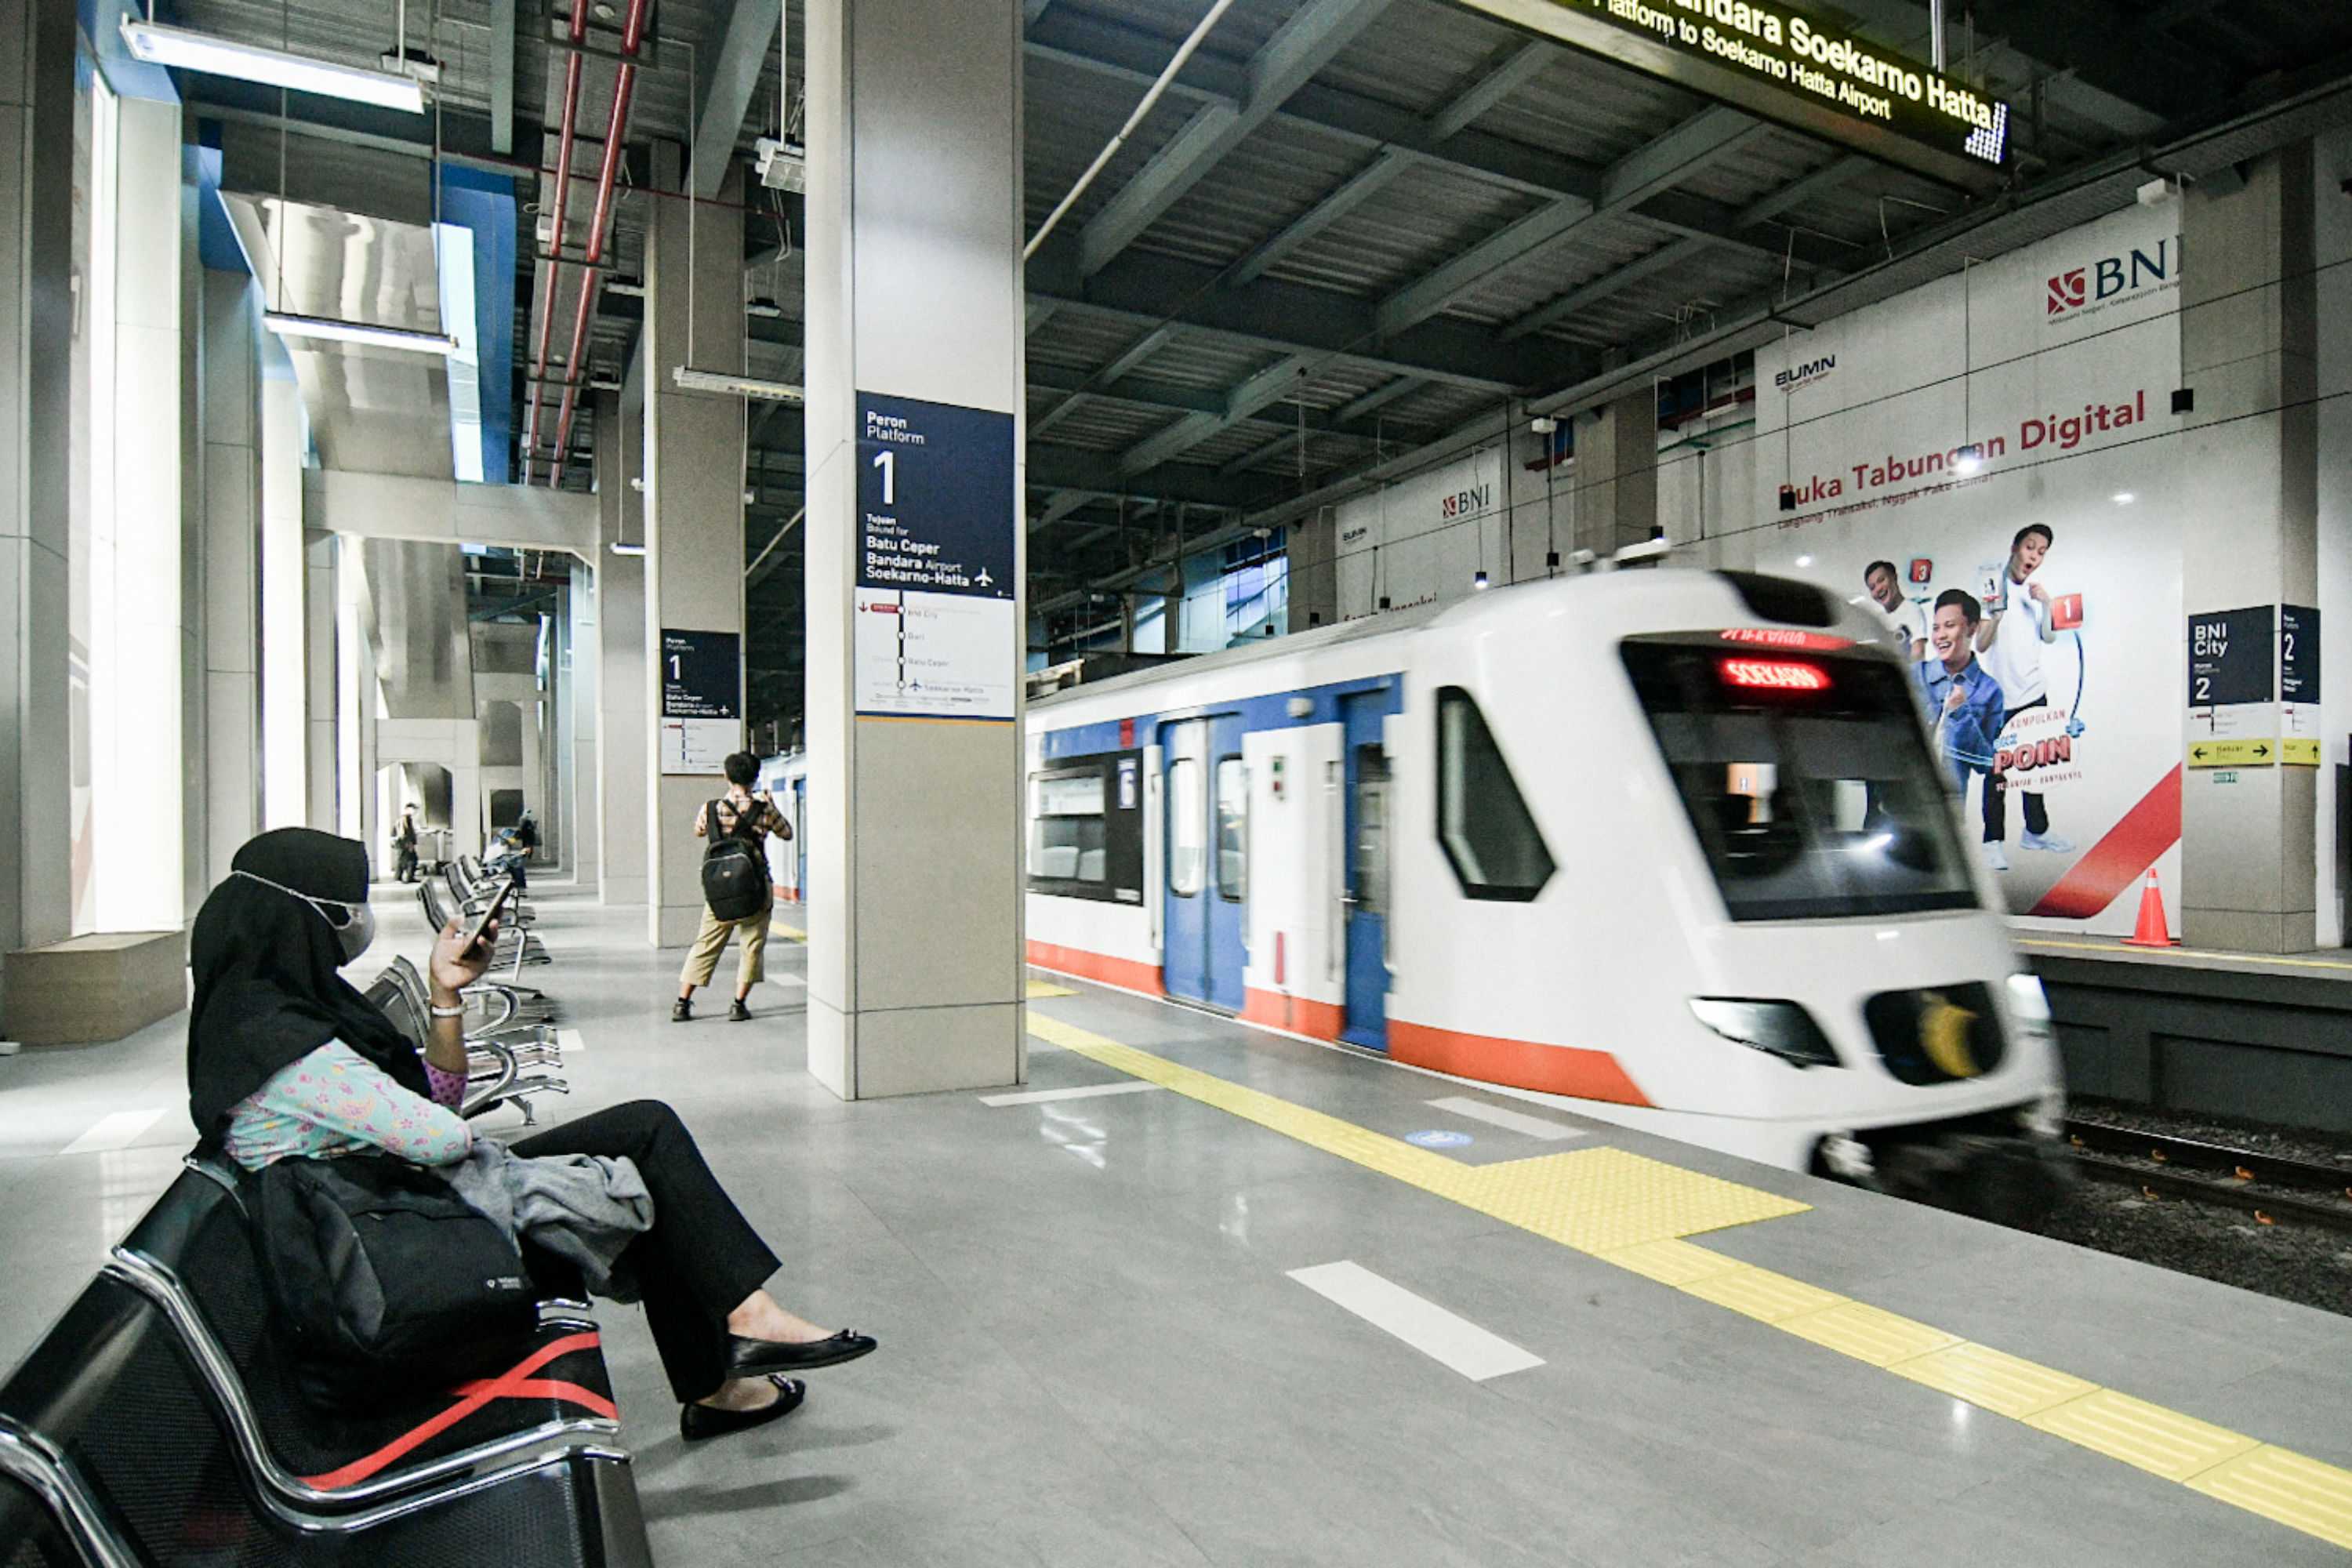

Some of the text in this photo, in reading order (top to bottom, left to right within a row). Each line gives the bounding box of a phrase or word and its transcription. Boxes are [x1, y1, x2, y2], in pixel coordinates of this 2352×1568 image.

[1679, 17, 1698, 45] to
[1701, 26, 1788, 79] Soekarno
[1790, 61, 1836, 100] Hatta
[1838, 80, 1892, 121] Airport
[1789, 17, 1921, 101] Soekarno
[1926, 74, 1993, 130] Hatta
[2095, 234, 2183, 302] BNI
[866, 410, 907, 430] Peron
[2020, 389, 2145, 450] Digital
[866, 424, 925, 445] Platform
[873, 449, 894, 505] 1
[1458, 484, 1490, 514] BNI
[866, 535, 941, 556] Batu Ceper
[866, 551, 963, 573] Bandara Airport
[1918, 564, 1927, 582] 3
[866, 565, 971, 587] Soekarno-Hatta
[2063, 593, 2071, 619] 1
[2195, 622, 2227, 641] BNI
[2195, 641, 2228, 658] City
[2284, 633, 2295, 661] 2
[670, 655, 681, 680] 1
[2195, 677, 2211, 700] 2
[1994, 735, 2071, 775] POIN
